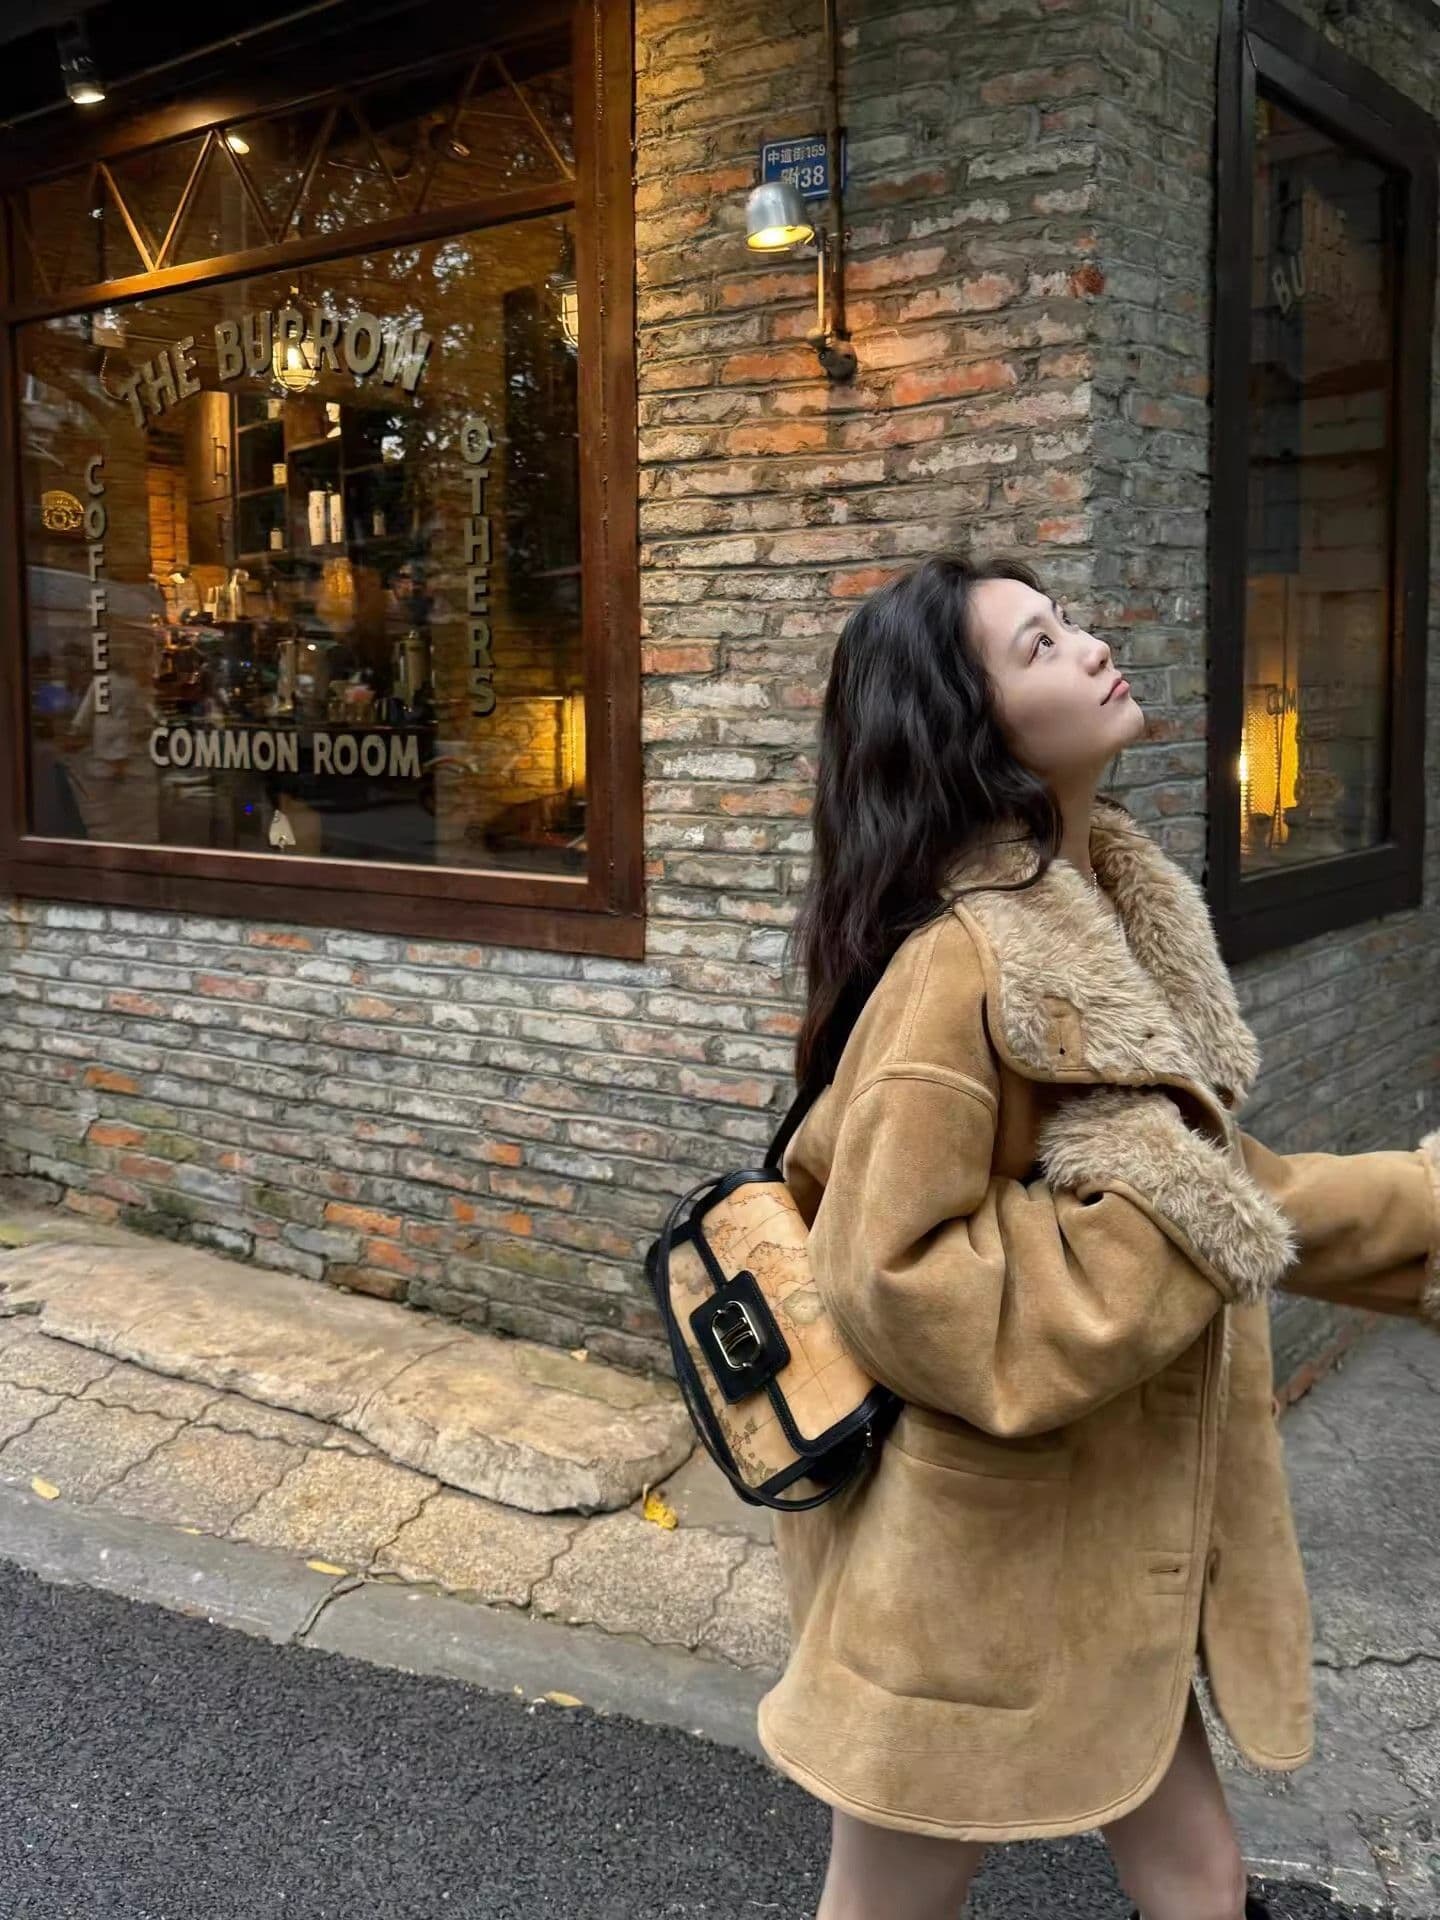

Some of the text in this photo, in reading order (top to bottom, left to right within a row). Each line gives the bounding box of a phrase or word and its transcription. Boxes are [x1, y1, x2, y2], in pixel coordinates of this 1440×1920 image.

[120, 308, 434, 429] THE BURROW
[84, 455, 109, 714] COFFEE
[460, 417, 496, 715] OTHERS
[150, 727, 422, 778] COMMON ROOM
